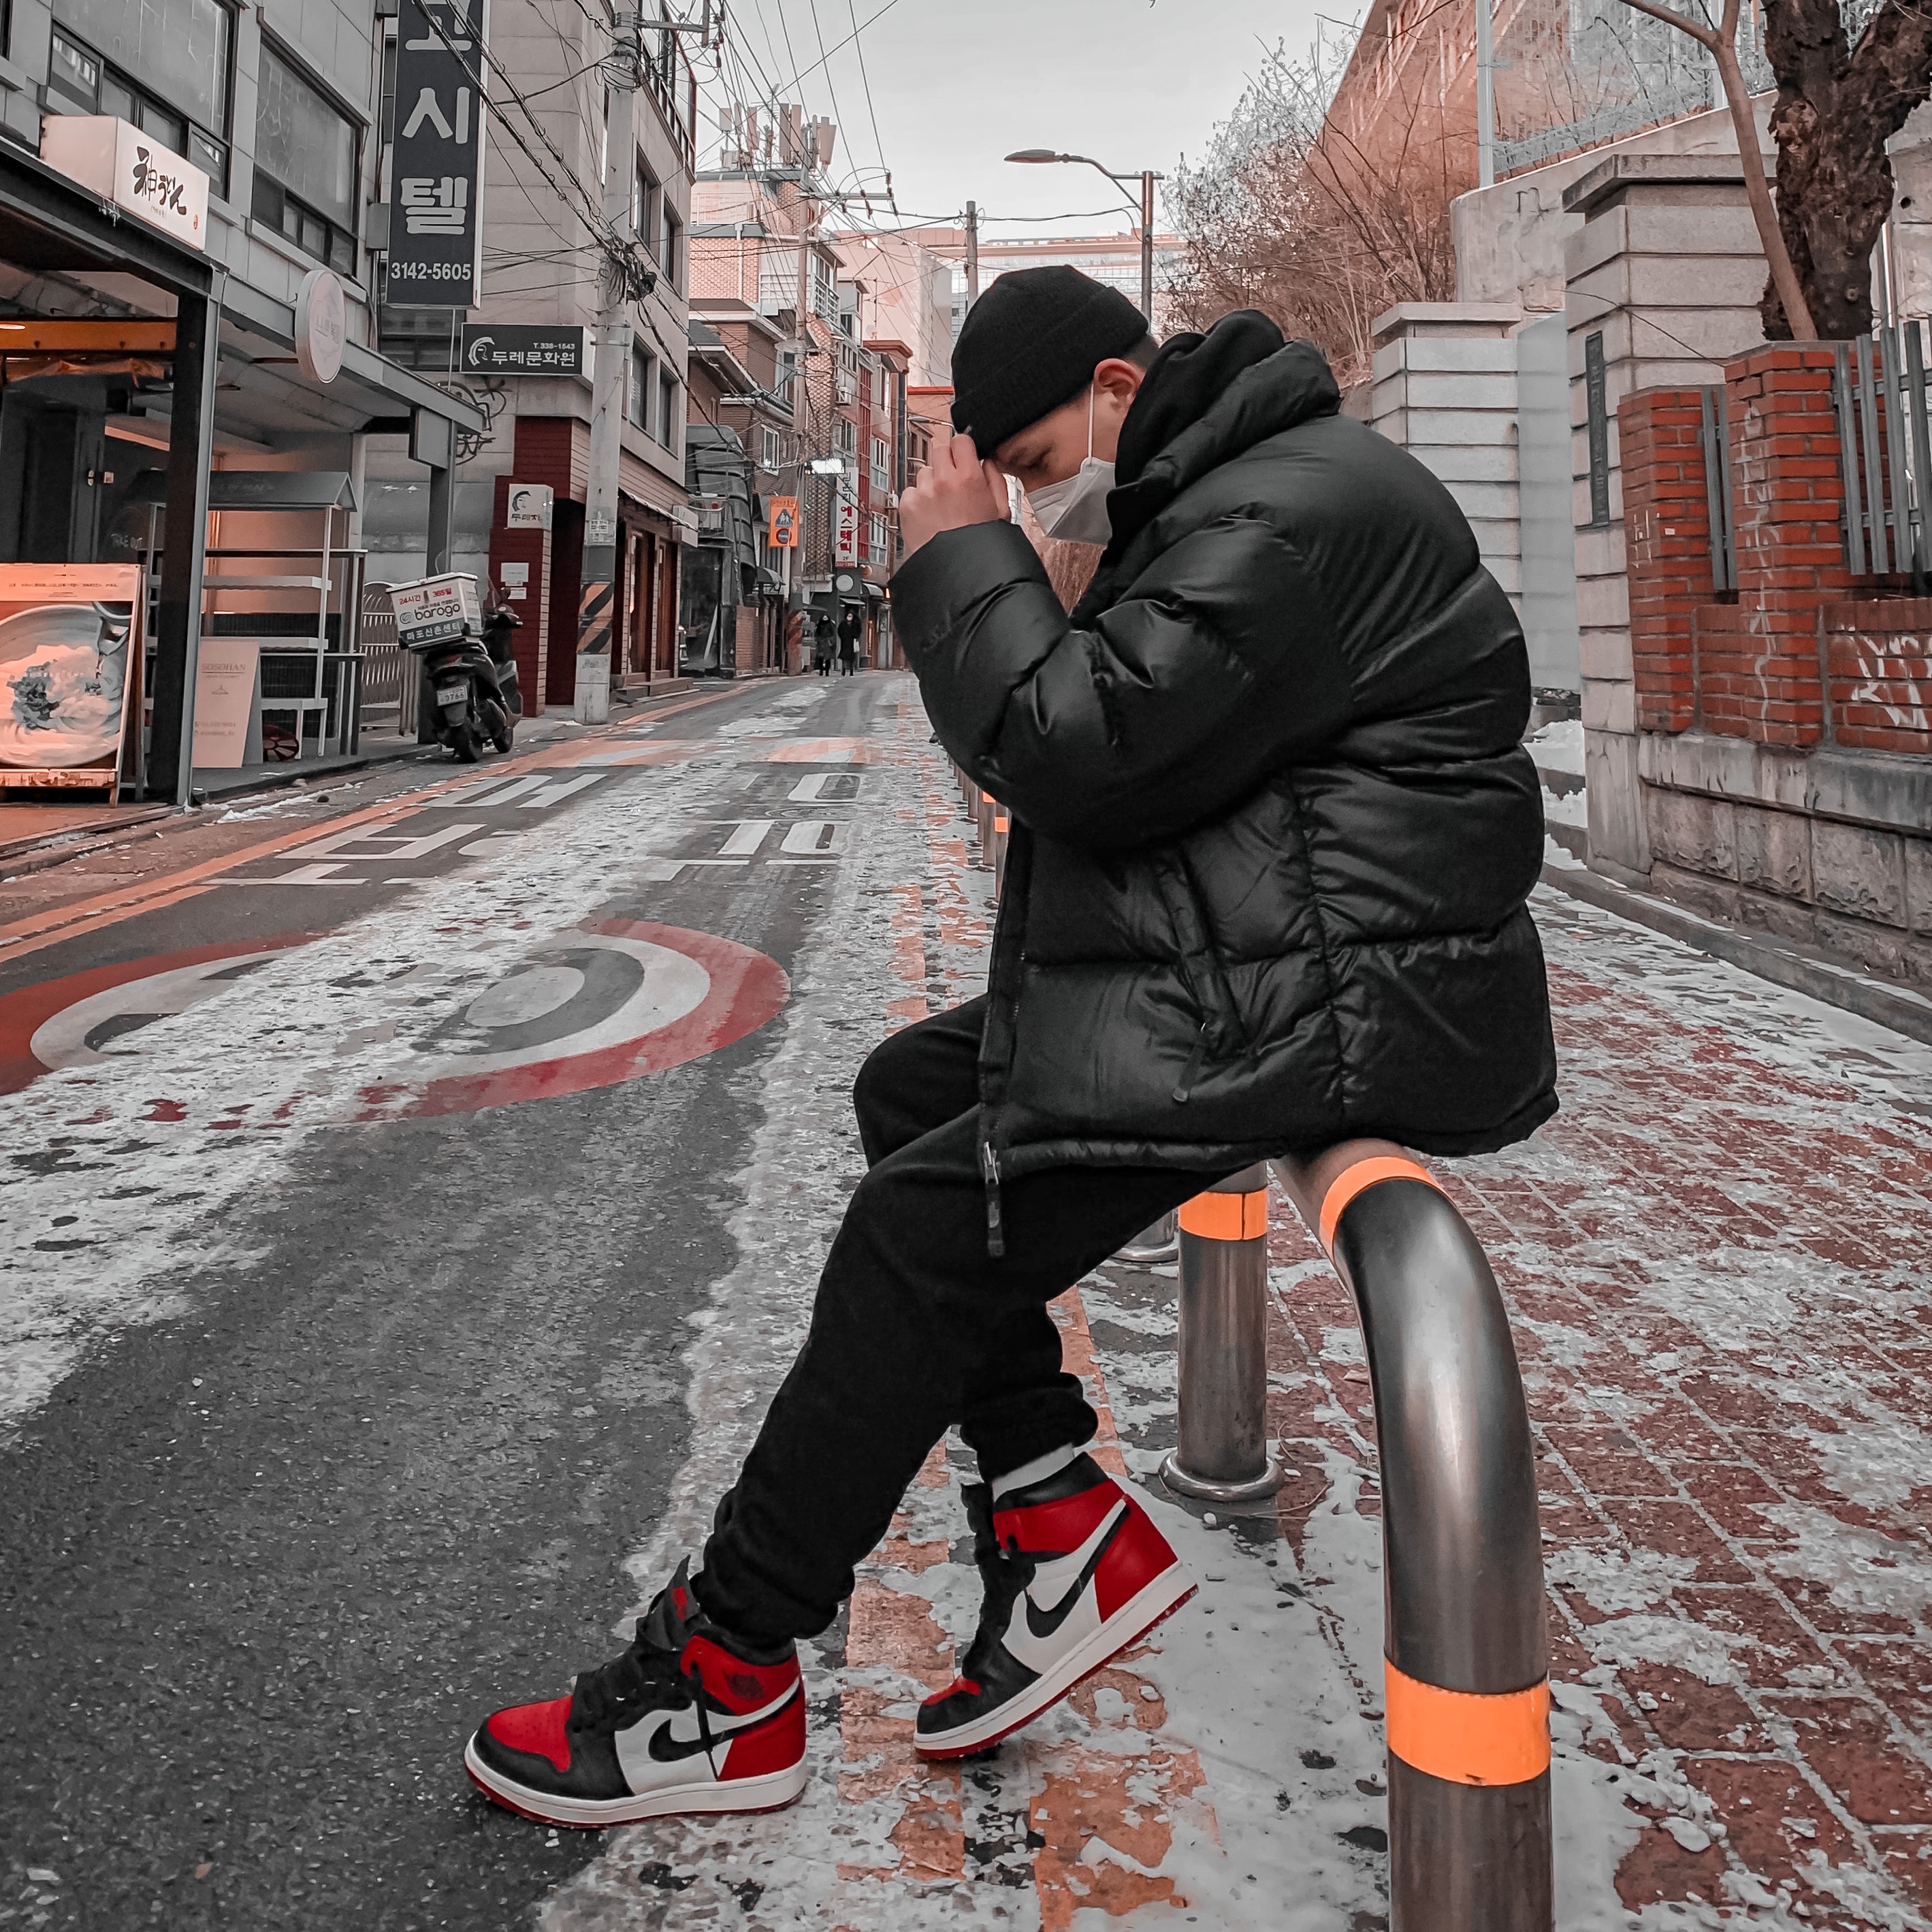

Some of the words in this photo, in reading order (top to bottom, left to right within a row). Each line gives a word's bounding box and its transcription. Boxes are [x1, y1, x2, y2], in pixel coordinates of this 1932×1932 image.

[401, 0, 472, 235] 고시텔
[391, 262, 471, 280] 3142-5605
[492, 351, 575, 366] 두레문화원
[840, 506, 852, 553] 에스테틱
[399, 594, 421, 605] 24시간
[432, 587, 452, 597] 365일
[414, 603, 460, 620] barogo
